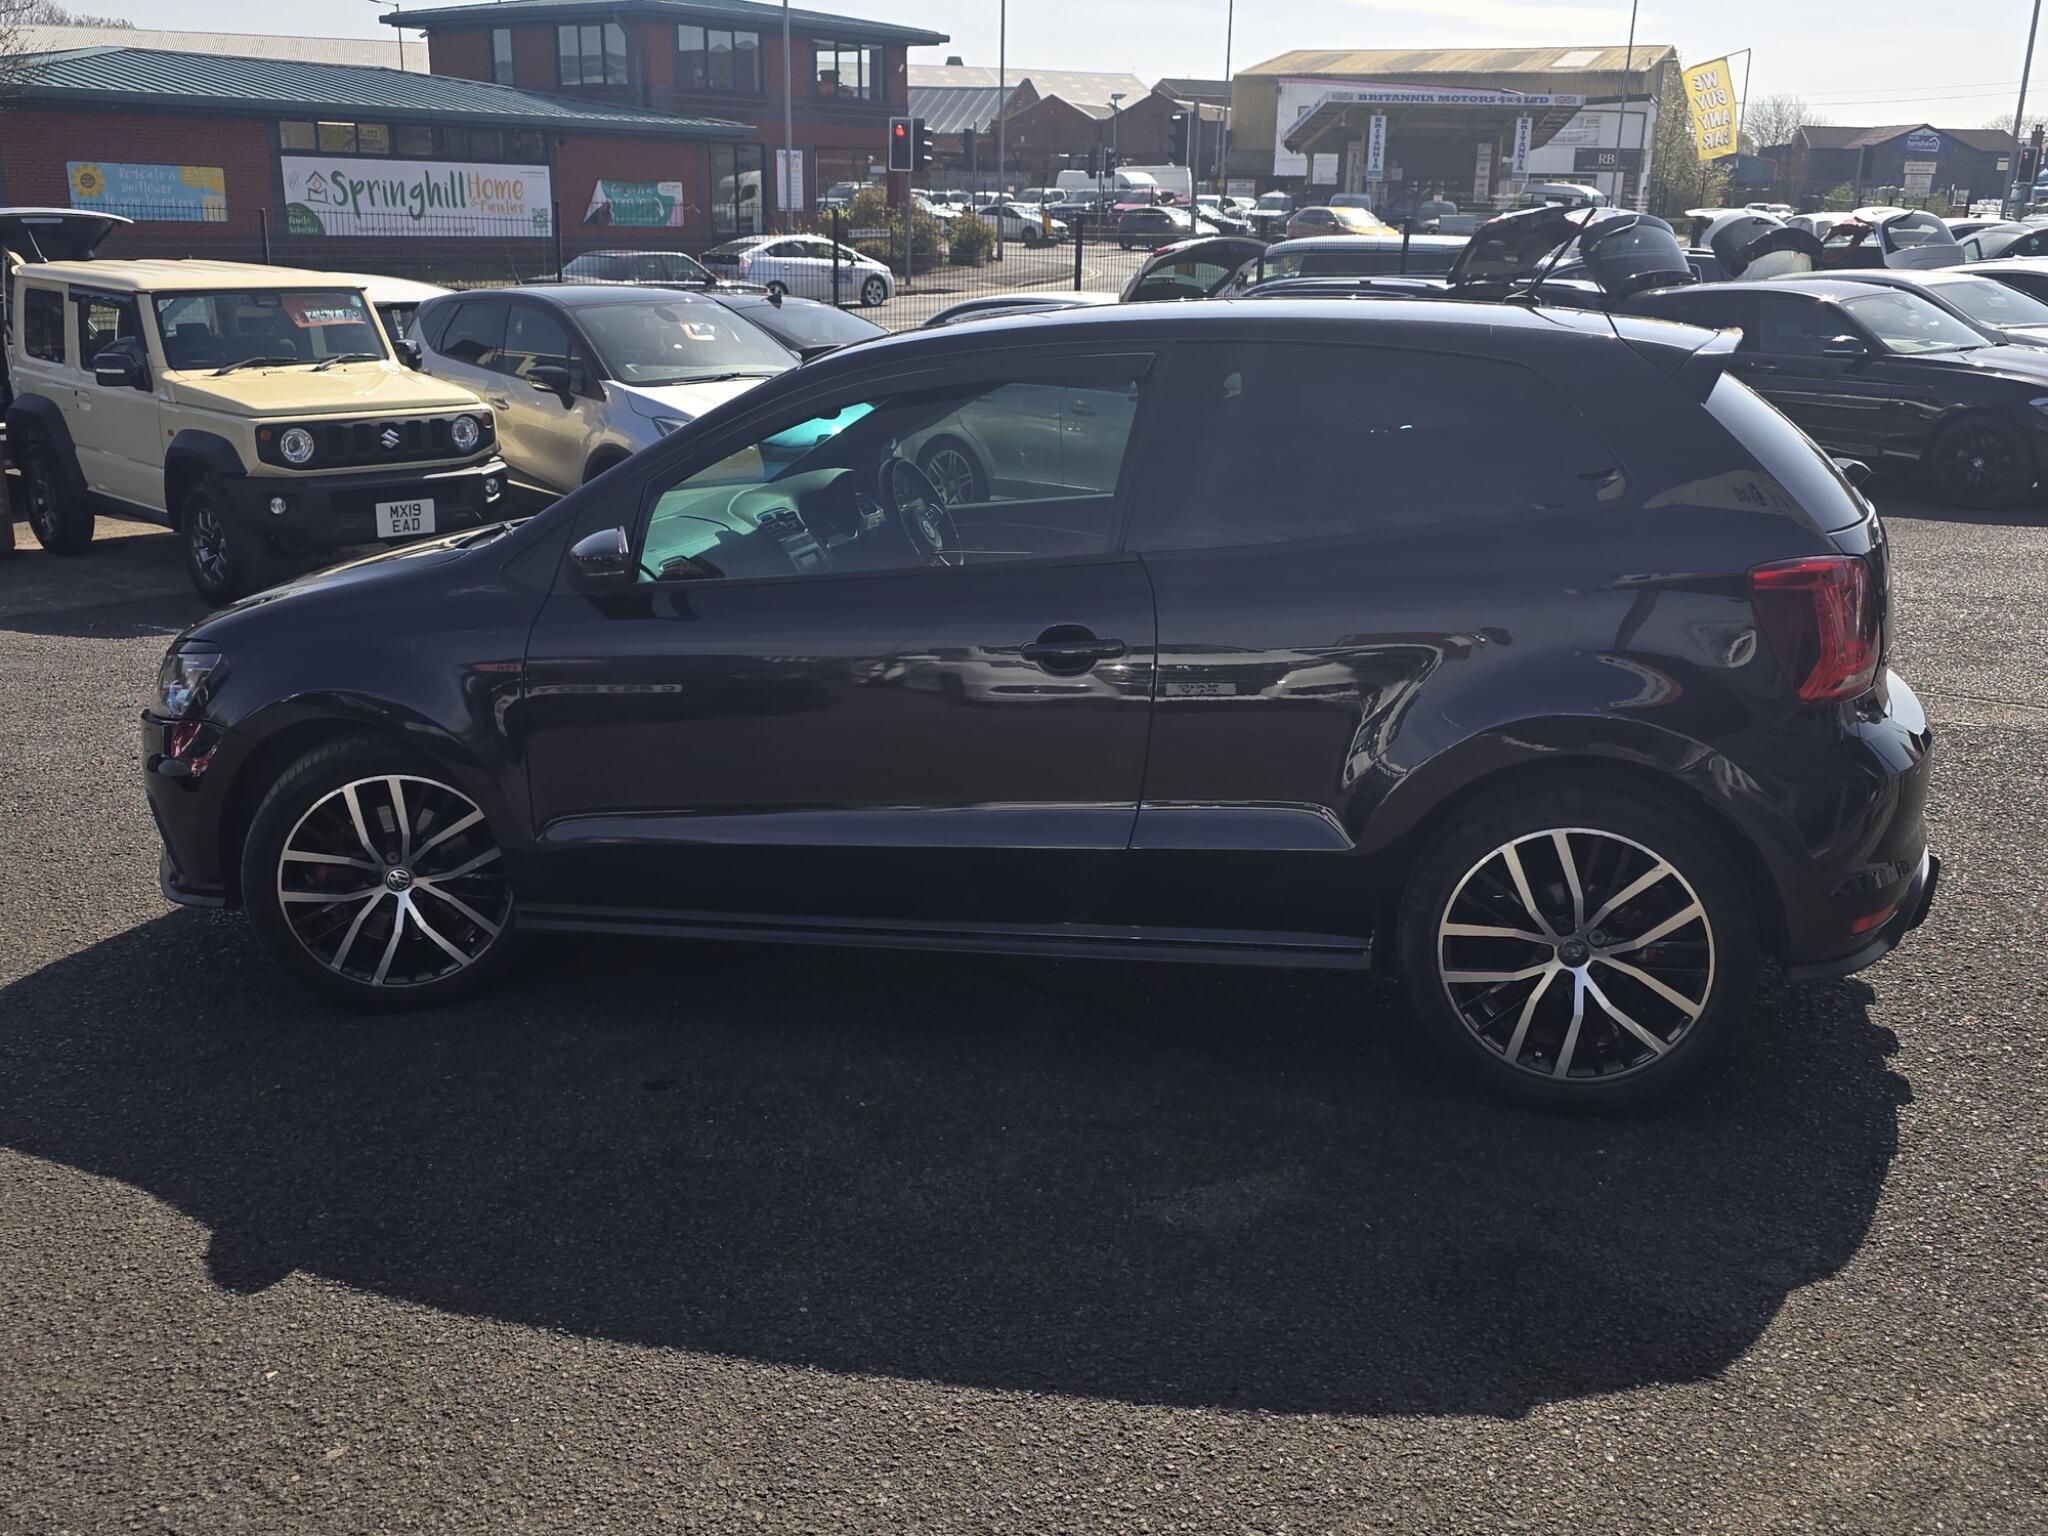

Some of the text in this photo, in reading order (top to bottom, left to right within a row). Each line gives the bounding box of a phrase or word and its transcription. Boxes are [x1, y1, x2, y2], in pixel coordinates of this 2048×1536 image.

[1358, 94, 1434, 103] BRITANNIA
[1438, 95, 1496, 103] MOTORS
[1372, 117, 1382, 169] BRITANNIA
[1516, 119, 1528, 171] BRITANNIA
[1598, 153, 1615, 165] RB
[330, 169, 524, 221] Springhill Home
[481, 200, 525, 215] Furniture
[390, 503, 421, 519] MX19
[392, 518, 420, 533] EAD
